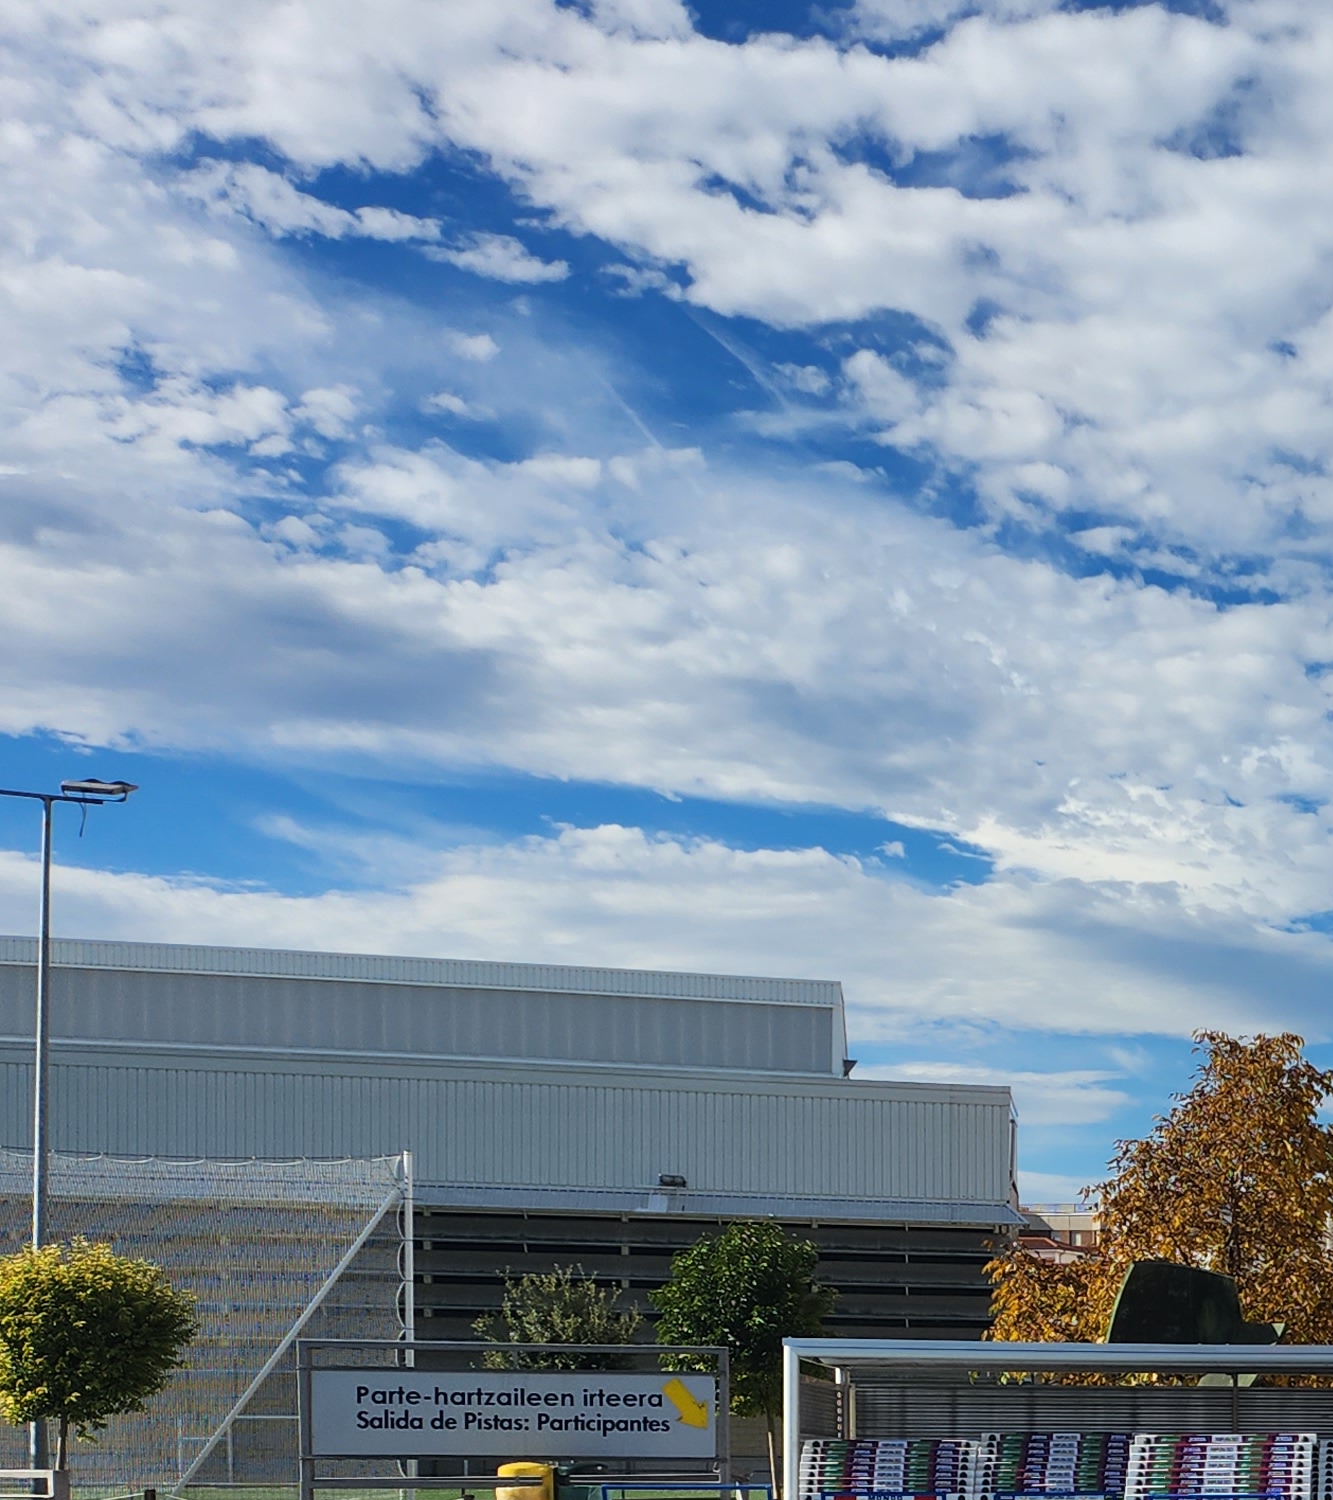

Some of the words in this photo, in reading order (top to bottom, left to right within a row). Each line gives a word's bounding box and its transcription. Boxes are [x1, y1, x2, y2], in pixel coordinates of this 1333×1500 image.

[356, 1386, 574, 1406] Parte-hartzaileen
[583, 1389, 663, 1408] irteera
[356, 1410, 423, 1430] Salida
[430, 1411, 457, 1430] de
[464, 1412, 529, 1432] Pistas:
[538, 1413, 670, 1436] Participantes
